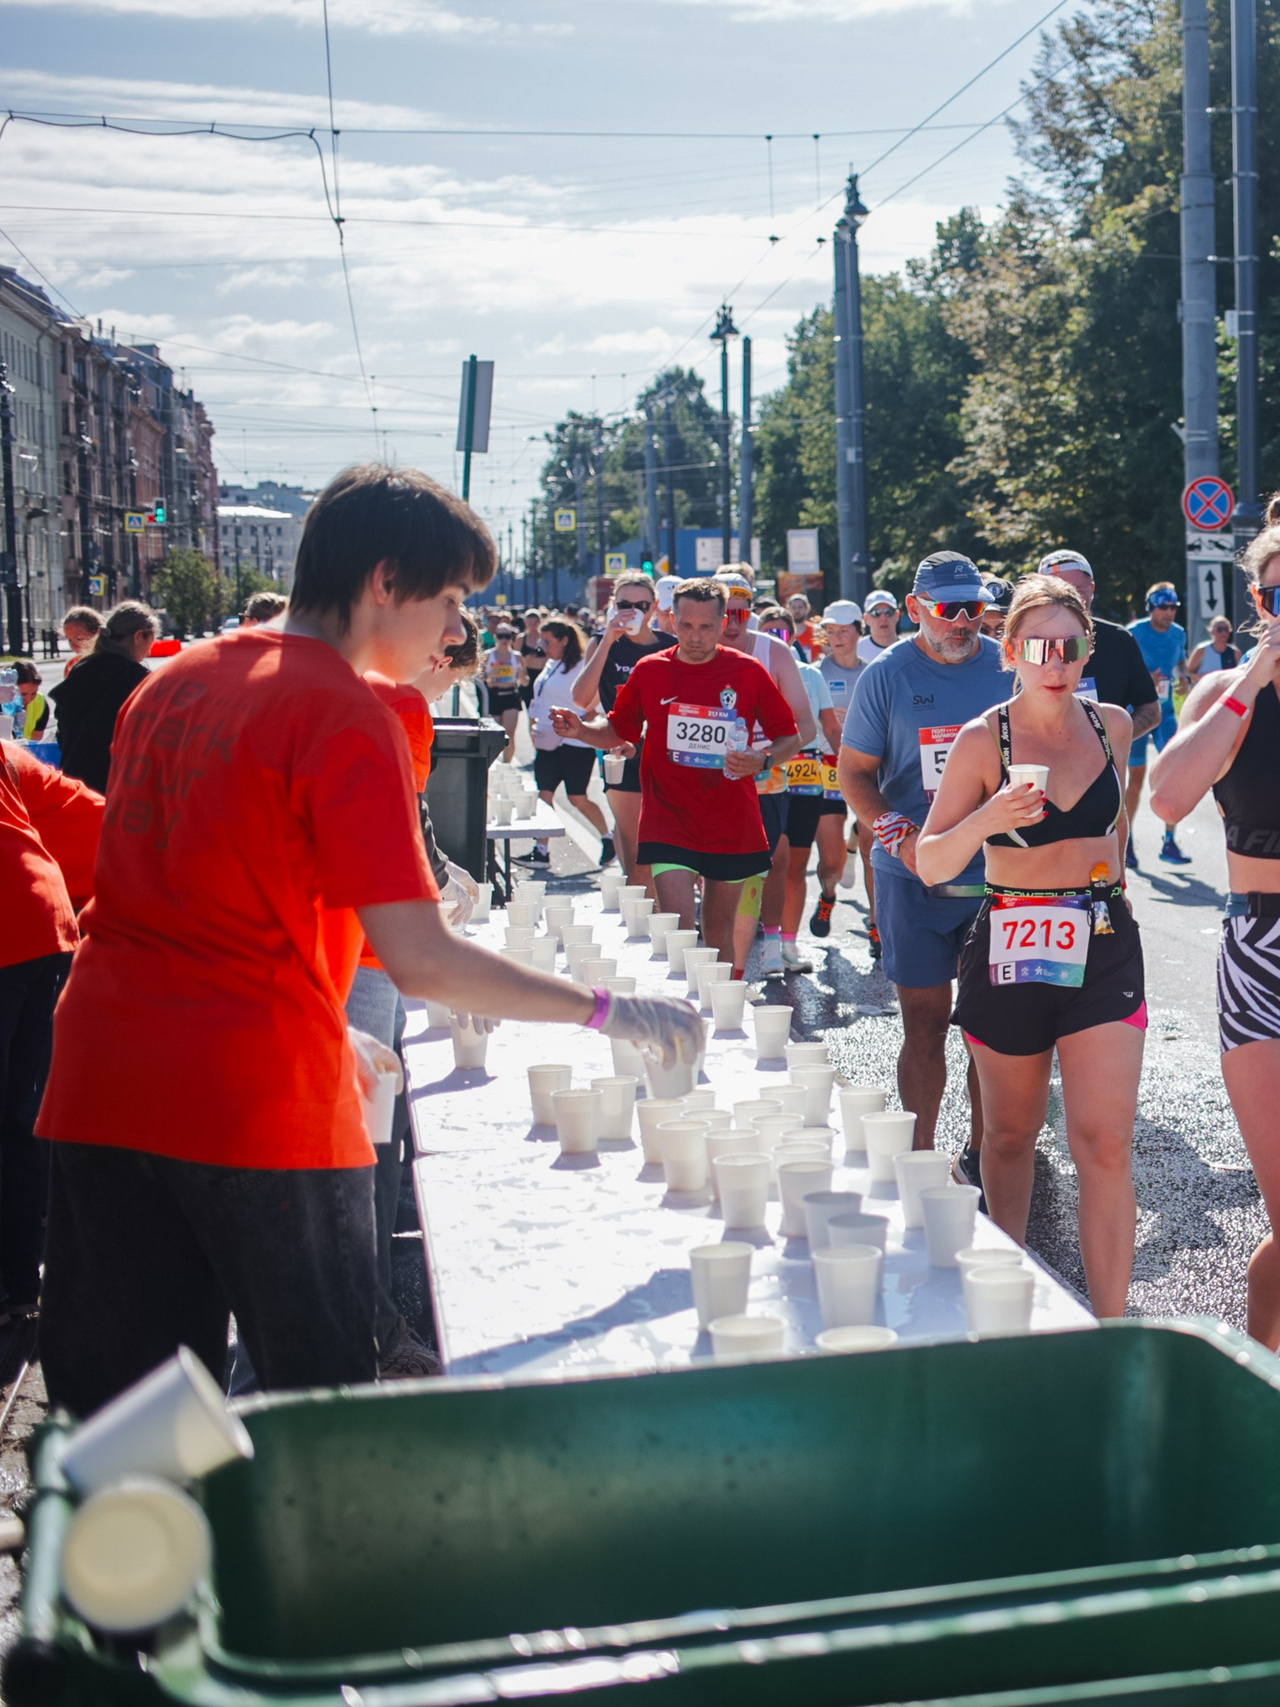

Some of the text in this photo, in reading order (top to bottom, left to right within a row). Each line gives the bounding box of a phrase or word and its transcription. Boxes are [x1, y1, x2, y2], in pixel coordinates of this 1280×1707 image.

[676, 722, 726, 744] 3280
[688, 742, 711, 751] ДЕНИС
[672, 751, 680, 762] E
[934, 750, 948, 775] 5
[786, 763, 817, 778] 4924
[828, 769, 837, 783] 8
[1002, 919, 1076, 950] 7213
[1002, 965, 1012, 981] E
